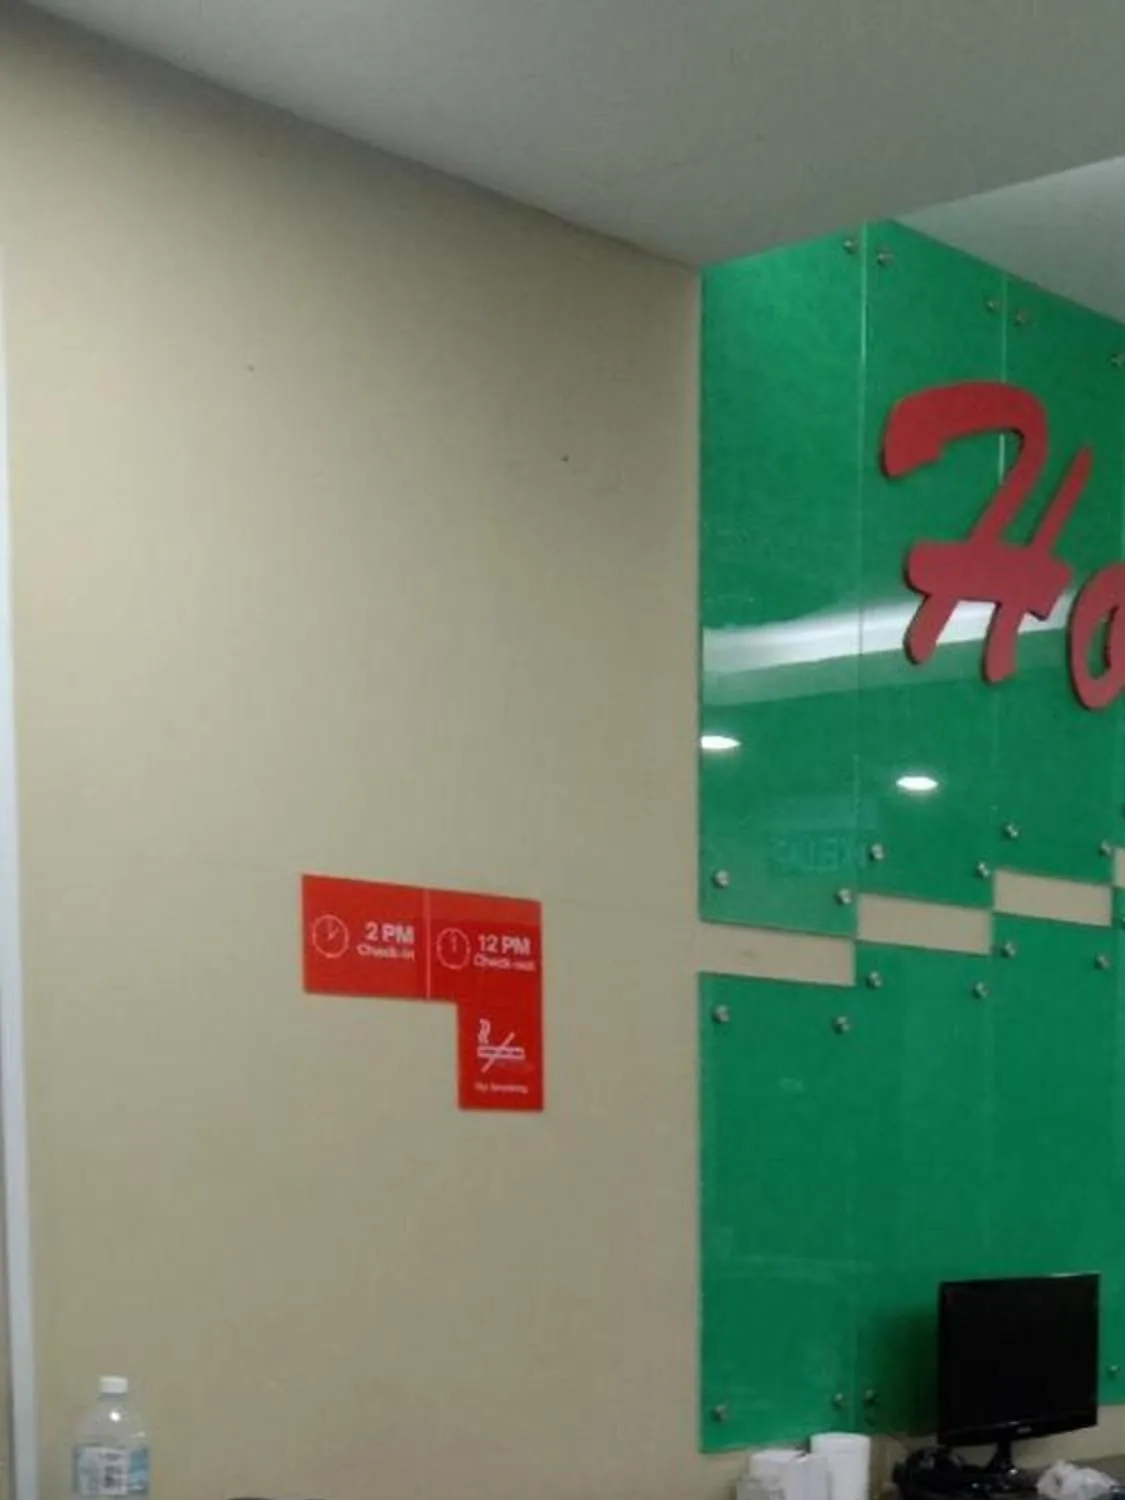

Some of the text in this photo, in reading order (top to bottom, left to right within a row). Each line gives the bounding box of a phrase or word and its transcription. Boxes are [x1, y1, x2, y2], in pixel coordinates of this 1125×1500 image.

[365, 921, 415, 945] 2 PM
[478, 934, 531, 956] 12 PM
